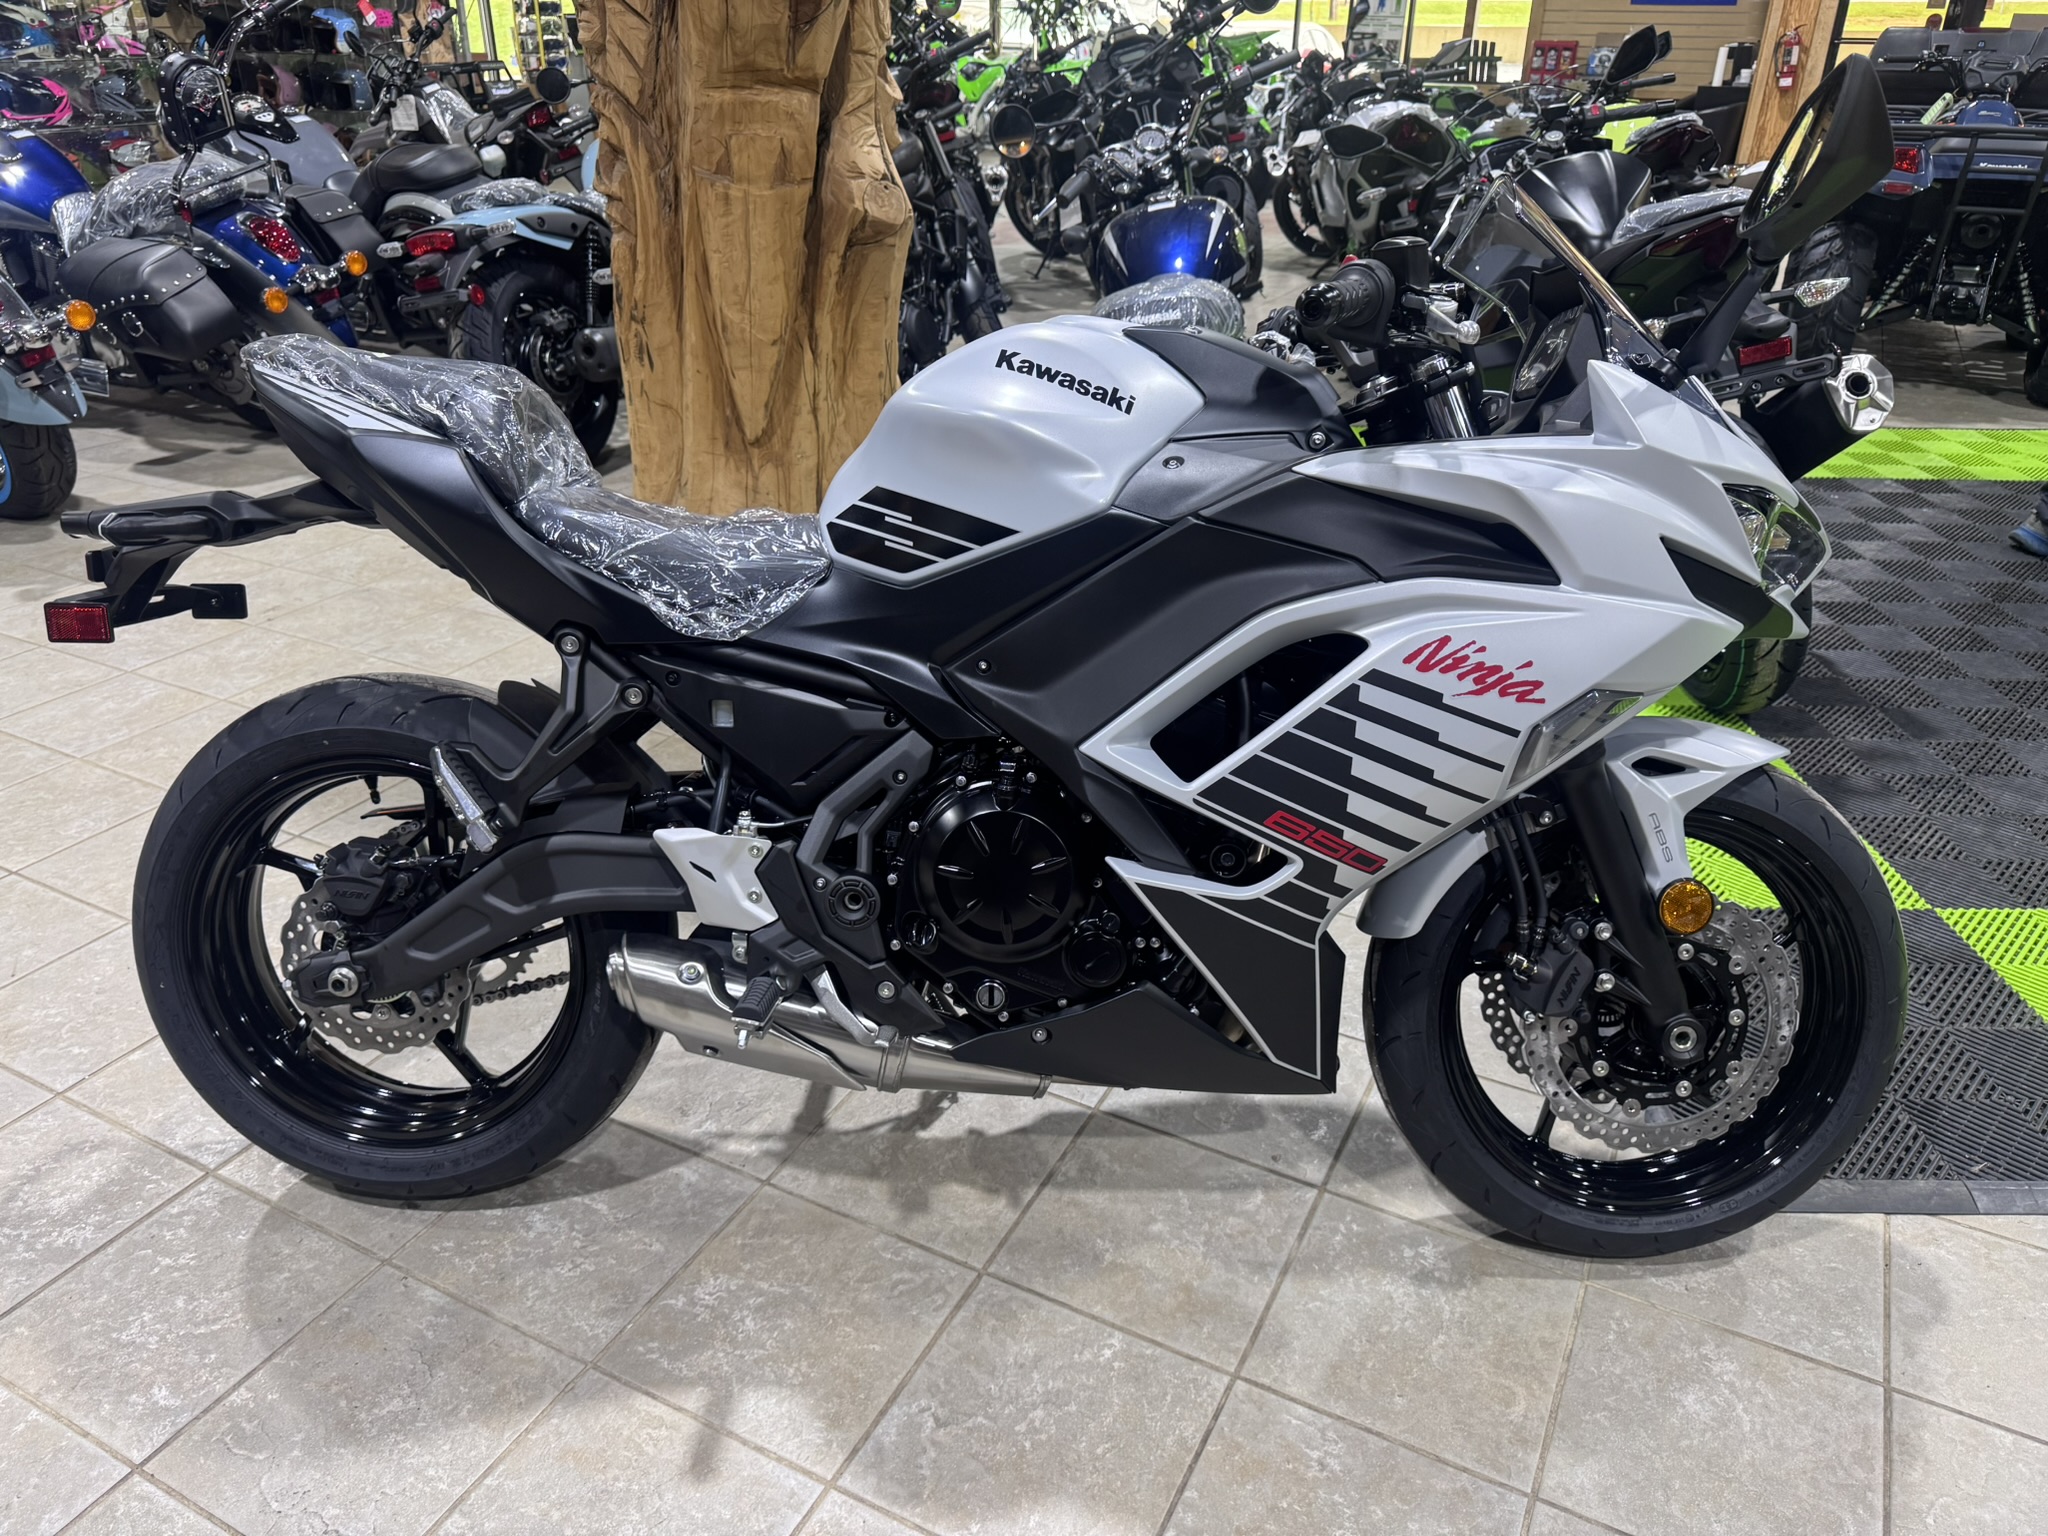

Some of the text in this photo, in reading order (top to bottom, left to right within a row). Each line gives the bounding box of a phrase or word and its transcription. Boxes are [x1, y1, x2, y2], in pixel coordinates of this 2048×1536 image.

[994, 348, 1137, 416] Kawasaki
[1402, 634, 1546, 704] Ninja
[1263, 810, 1389, 873] 650
[1648, 812, 1674, 863] ABS
